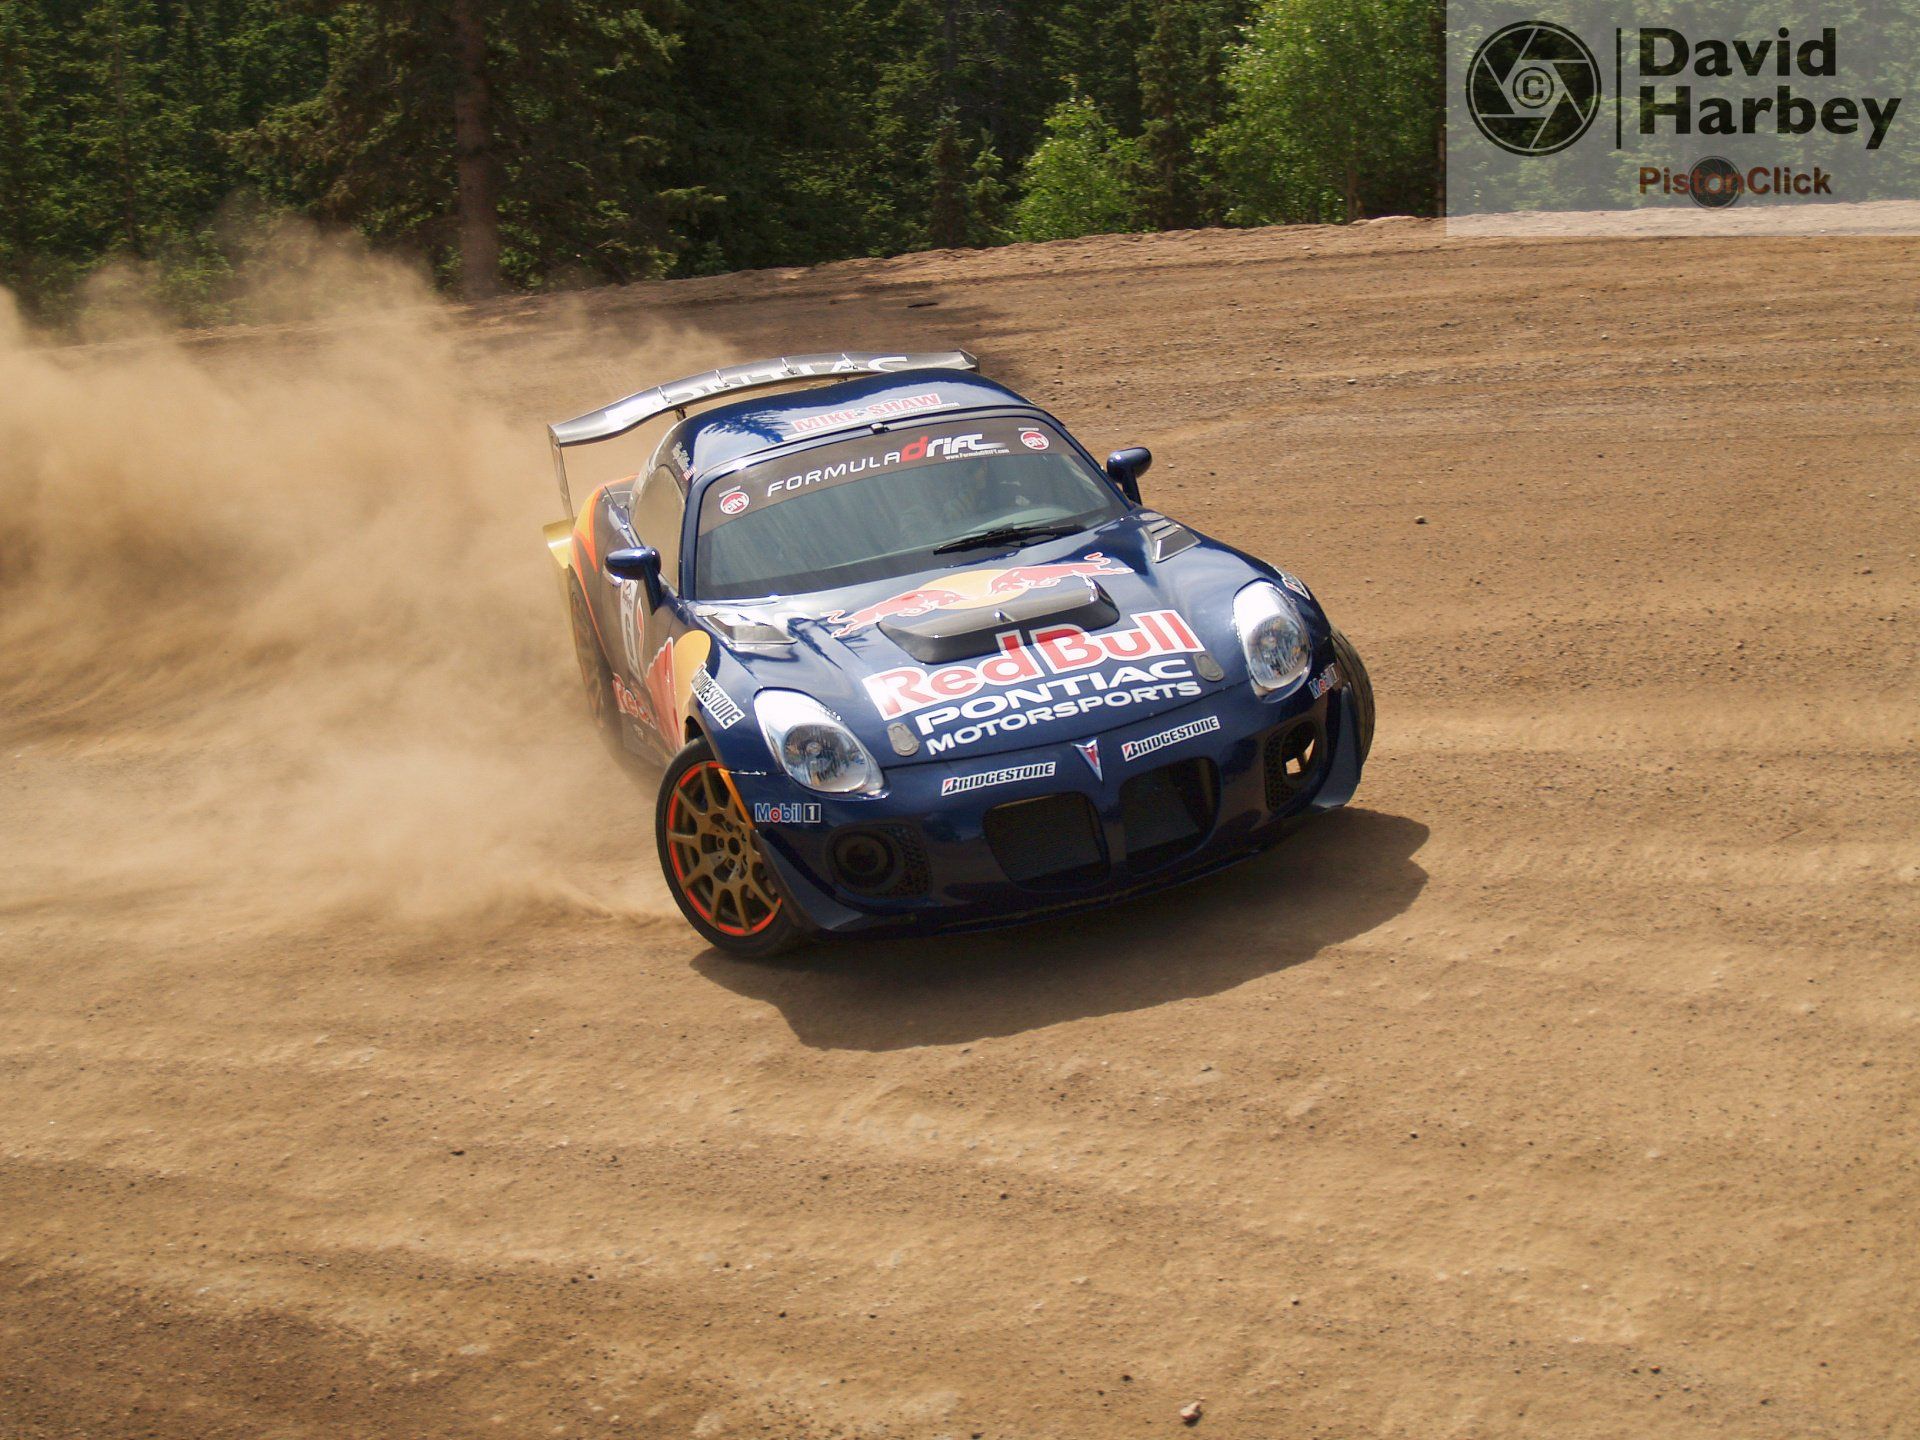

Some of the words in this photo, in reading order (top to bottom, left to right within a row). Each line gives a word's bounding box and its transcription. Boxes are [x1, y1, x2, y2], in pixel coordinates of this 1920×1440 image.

[792, 409, 857, 431] MIKE
[868, 393, 942, 416] SHAW
[767, 451, 901, 497] FORMULA
[864, 631, 1043, 719] Red
[1031, 611, 1203, 673] Bull
[915, 659, 1193, 735] PONTIAC
[926, 681, 1202, 755] MOTORSPORTS
[1123, 716, 1219, 759] BRIDGESTONE
[943, 763, 1055, 794] BRIDGESTONE
[755, 803, 802, 823] Mobil
